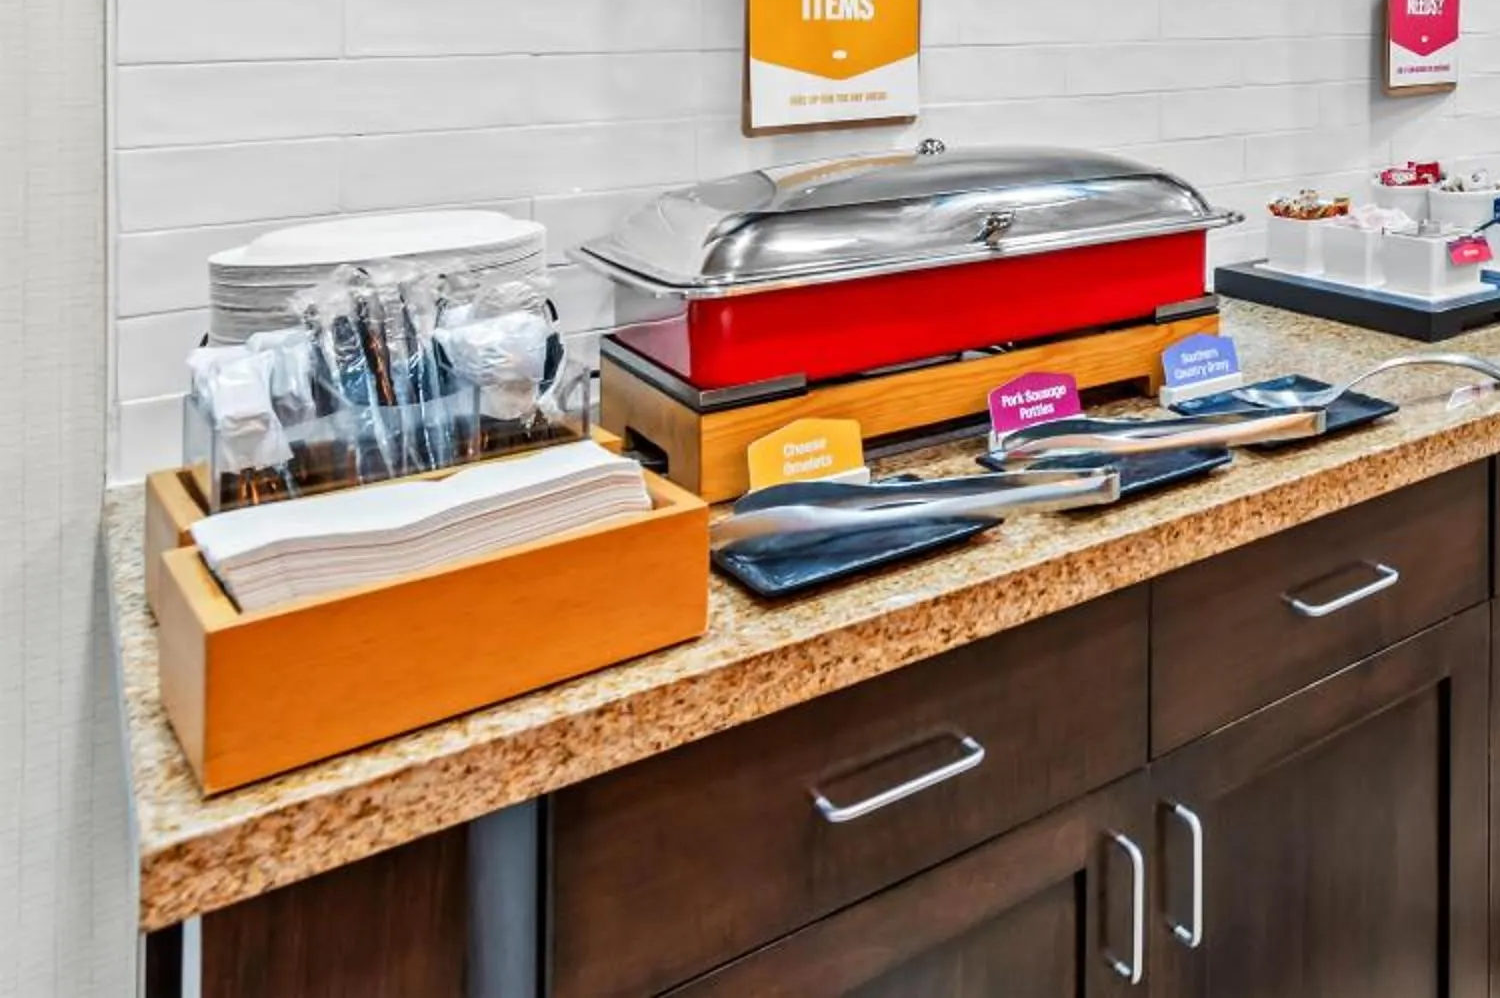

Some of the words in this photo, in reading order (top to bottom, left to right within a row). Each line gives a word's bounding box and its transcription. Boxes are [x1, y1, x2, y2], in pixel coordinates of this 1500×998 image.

[1001, 391, 1024, 408] Pork
[1024, 385, 1067, 403] Sausage
[1020, 402, 1055, 420] Patties
[783, 436, 828, 458] Cheese
